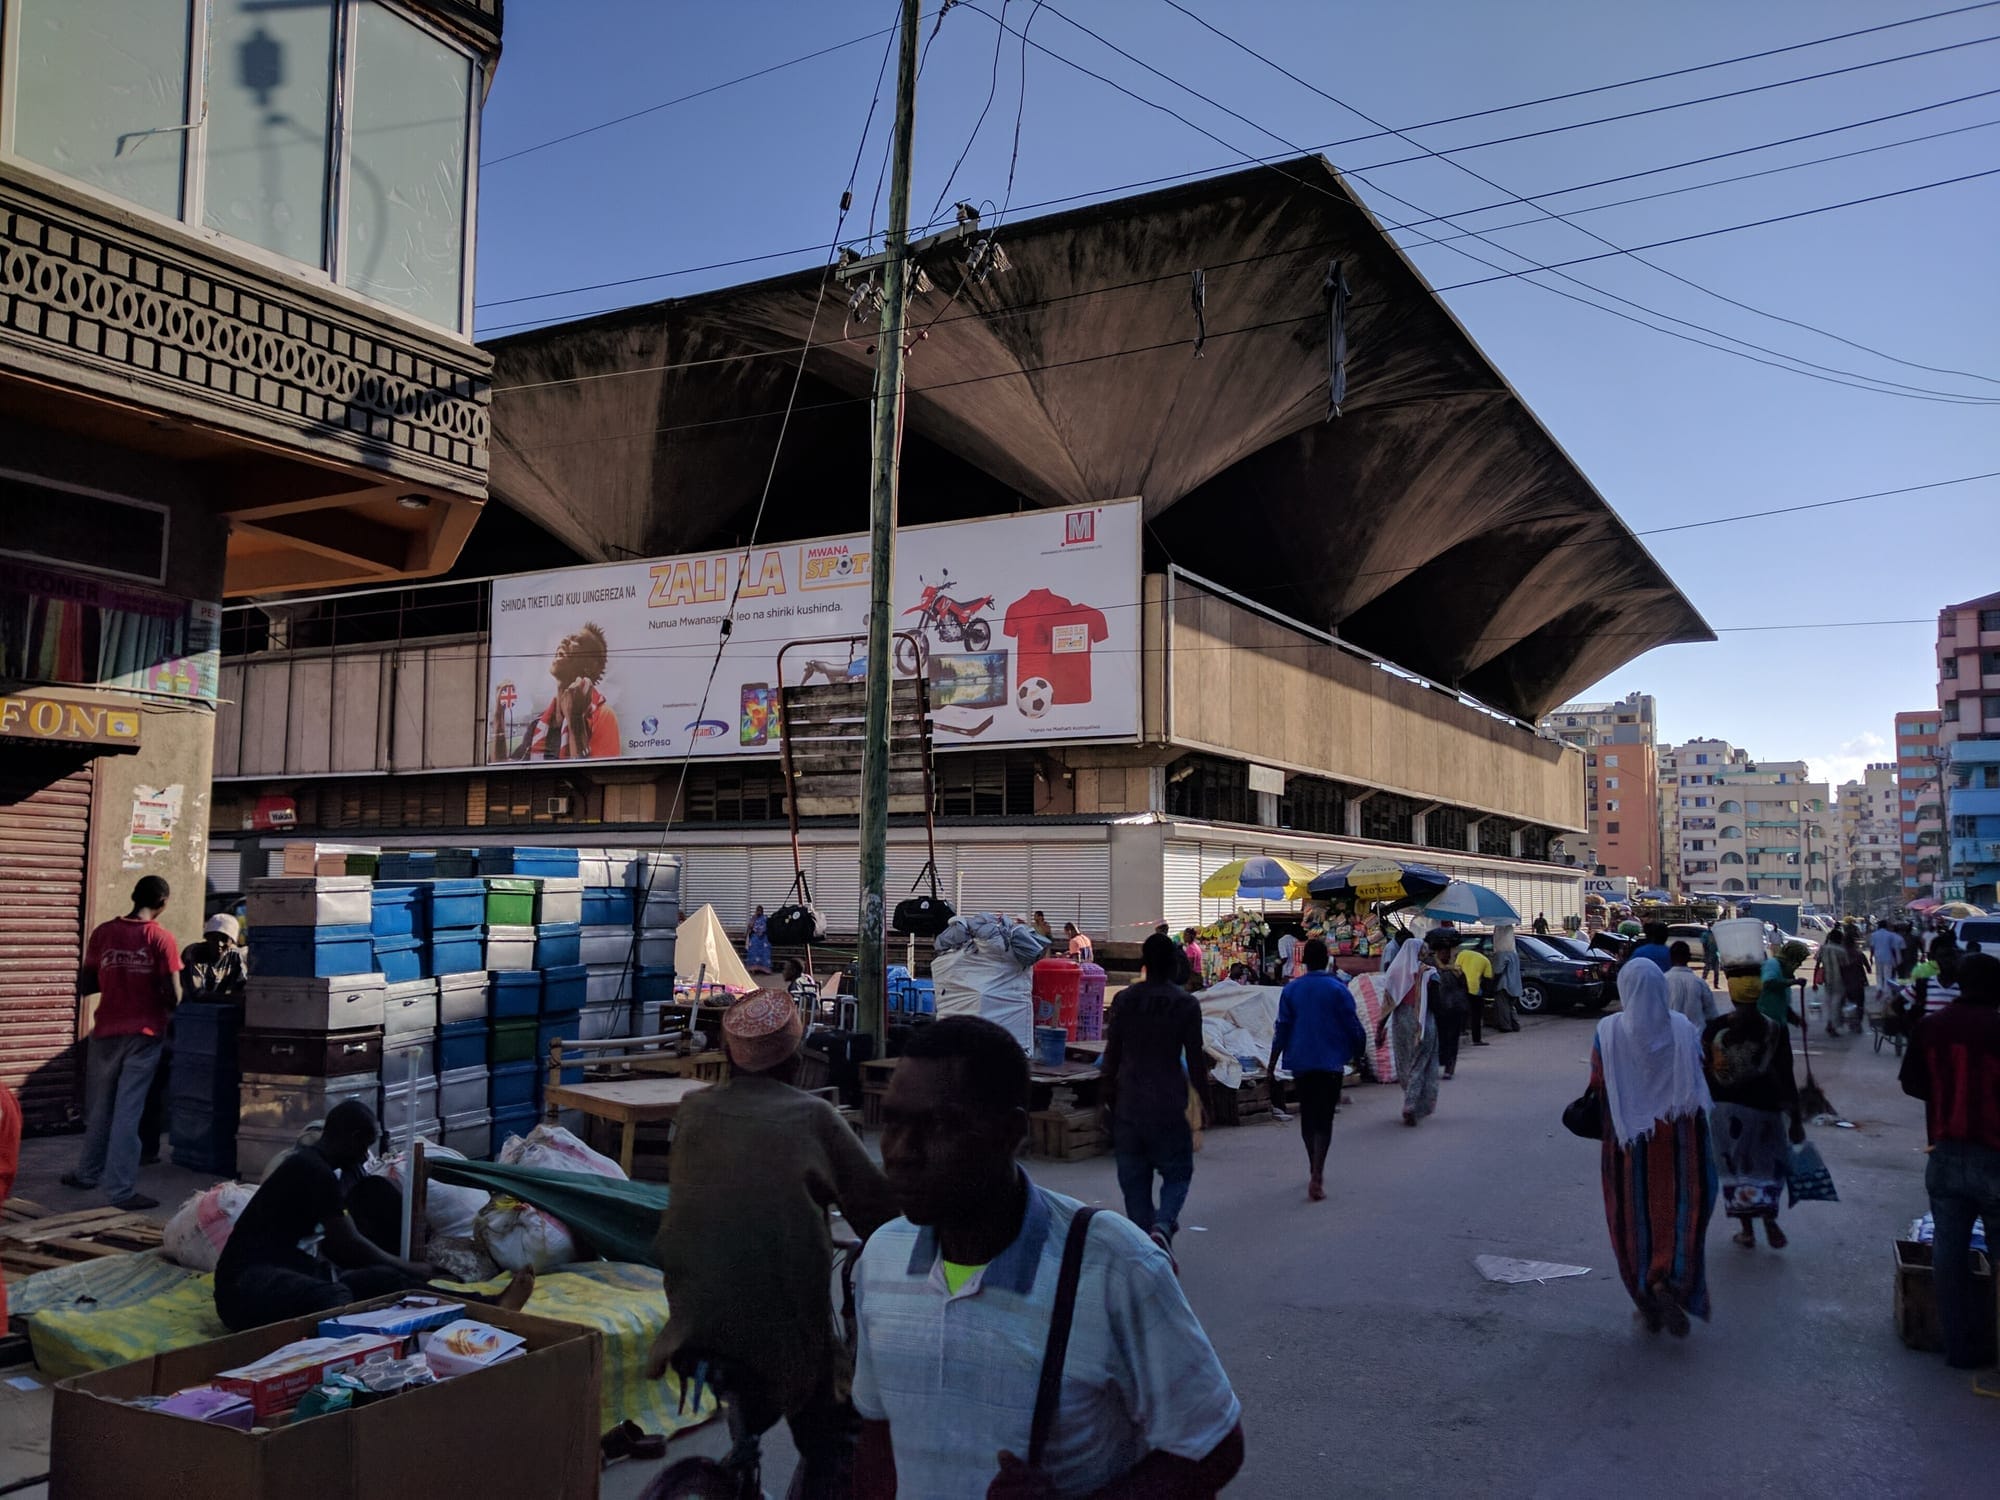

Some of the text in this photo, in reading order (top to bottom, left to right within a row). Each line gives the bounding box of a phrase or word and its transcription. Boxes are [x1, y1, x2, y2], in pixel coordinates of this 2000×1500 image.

[808, 545, 849, 558] MWANA
[647, 551, 787, 608] ZALI LA
[806, 553, 872, 580] SPOT
[500, 585, 637, 612] SHINDA TIKETI LIGI KUU UINGEREZA NA
[648, 617, 678, 630] Nunua
[736, 612, 751, 621] leo
[753, 612, 765, 620] na
[766, 606, 795, 618] shiriki
[796, 602, 843, 614] kushinda.
[628, 738, 671, 749] SportPesa
